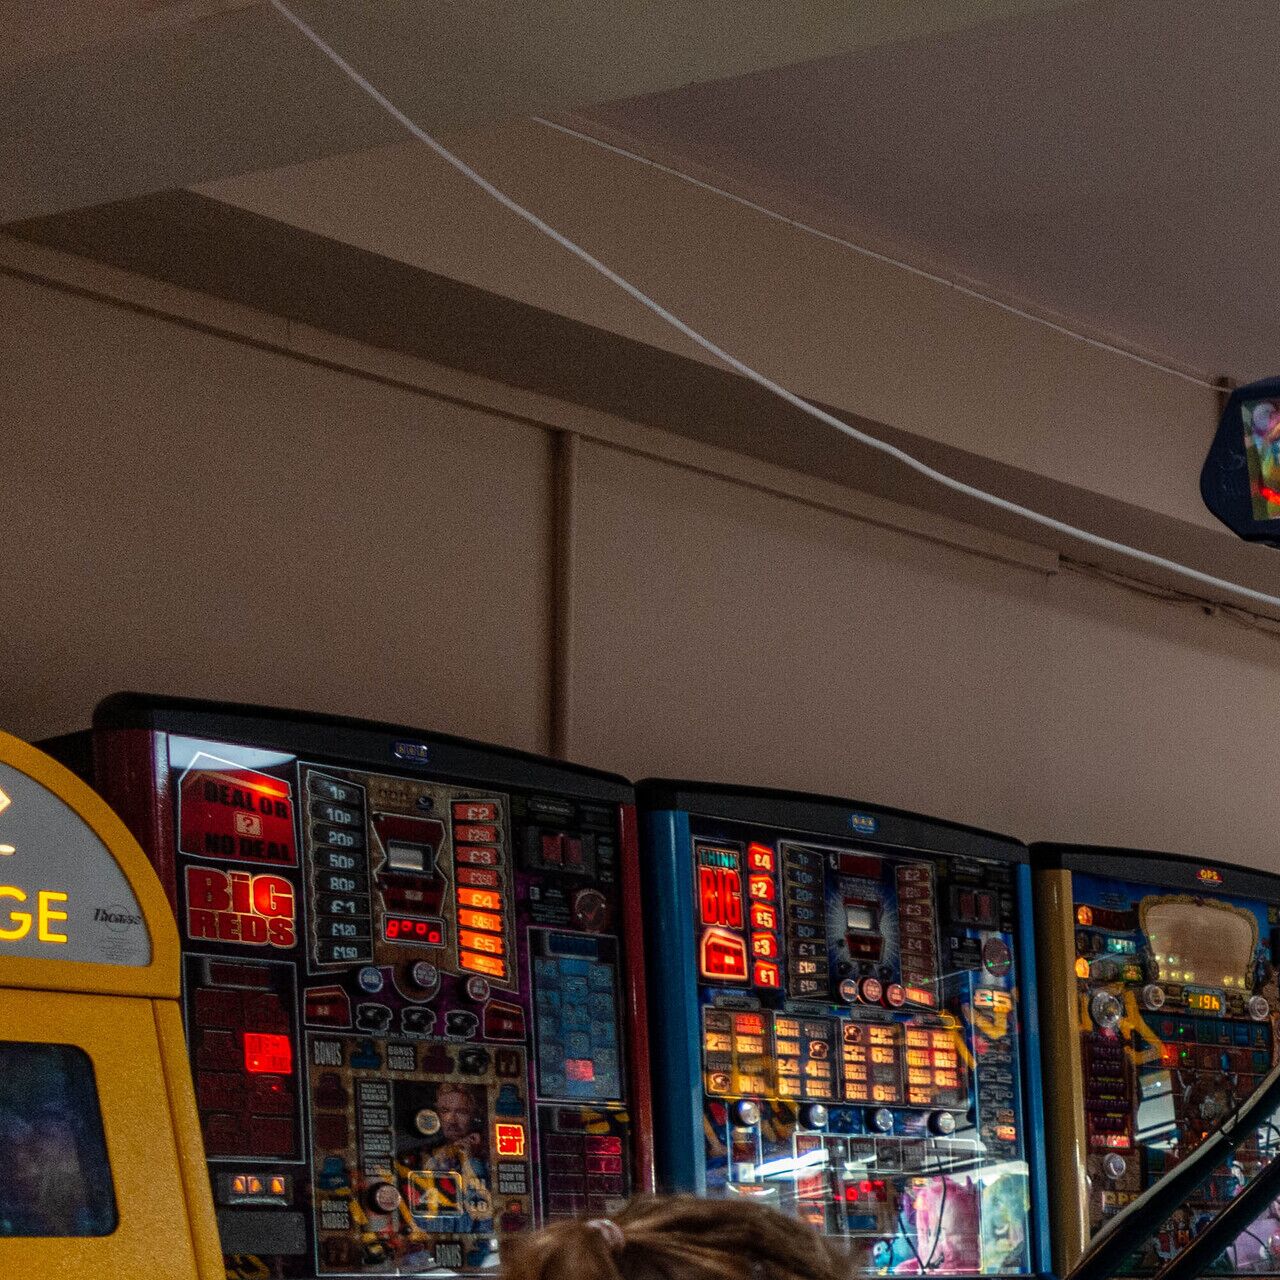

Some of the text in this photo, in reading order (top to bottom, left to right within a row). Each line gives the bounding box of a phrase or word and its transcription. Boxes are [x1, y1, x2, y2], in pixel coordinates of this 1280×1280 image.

[205, 781, 288, 819] DEAL OR
[205, 832, 290, 860] NO DEAL
[700, 849, 738, 868] THINK
[754, 853, 771, 870] £4
[700, 866, 743, 928] BIG
[751, 881, 768, 898] £2
[471, 894, 493, 908] £4
[756, 911, 773, 928] £5
[188, 908, 297, 949] REDS
[473, 937, 496, 951] £5
[753, 938, 771, 955] £3
[760, 968, 775, 986] £1
